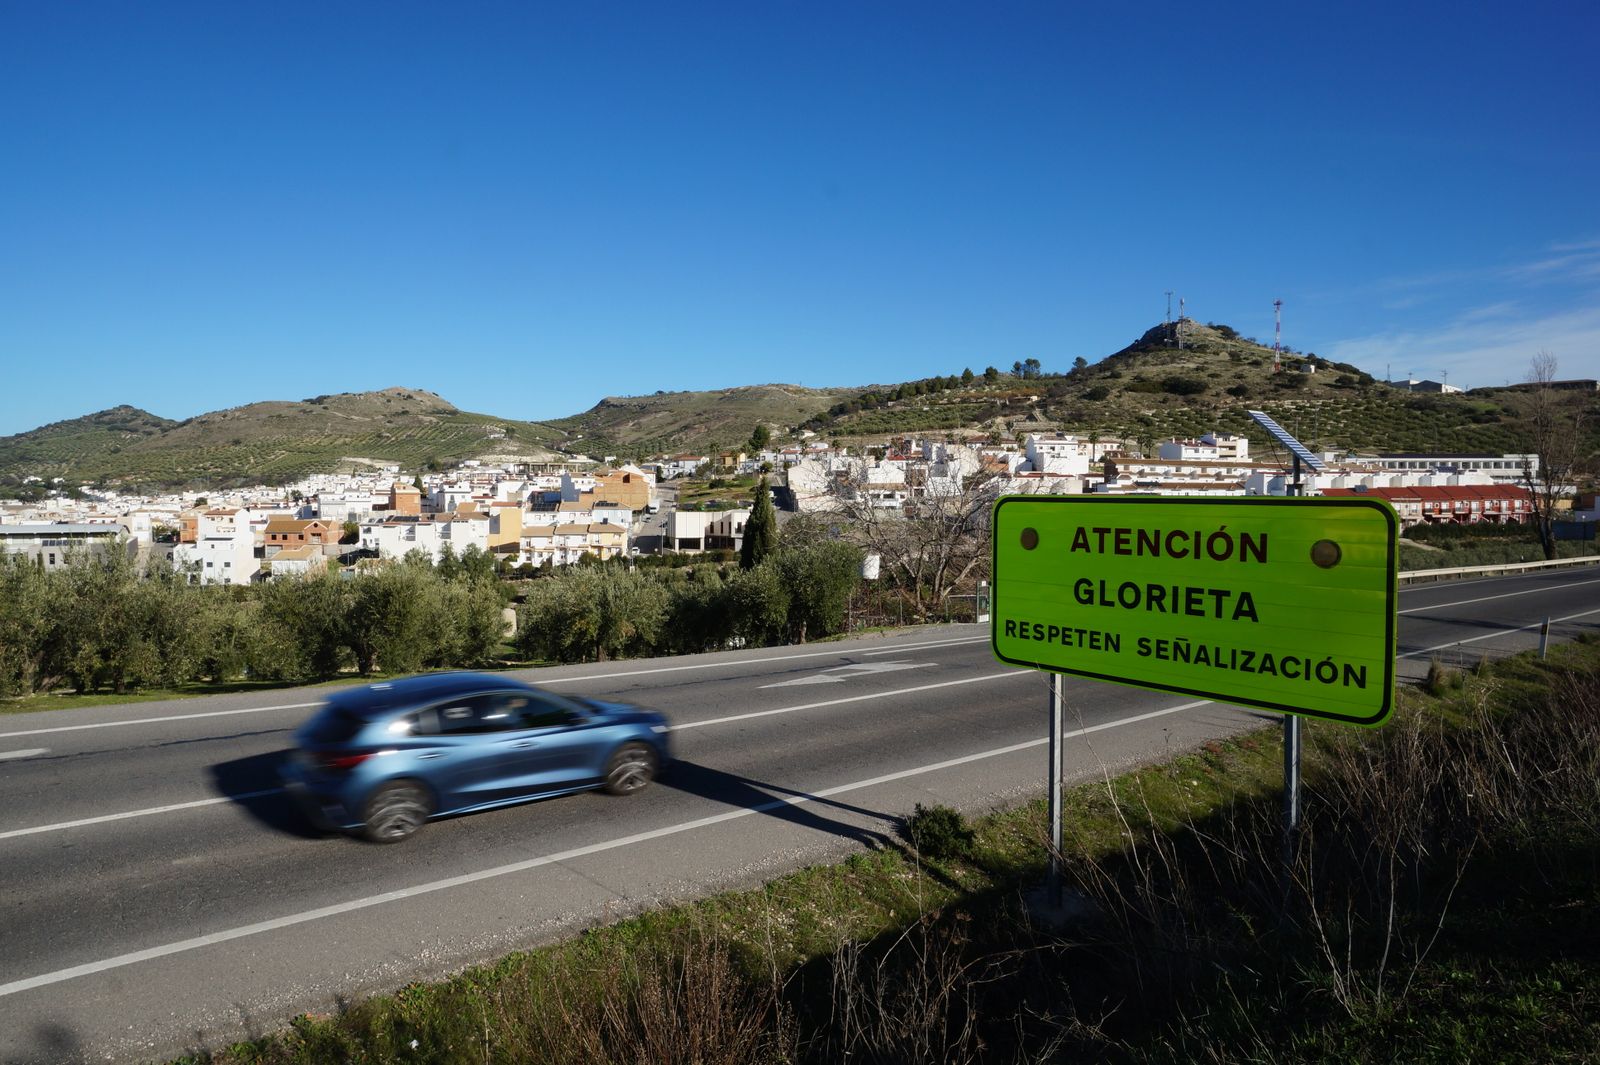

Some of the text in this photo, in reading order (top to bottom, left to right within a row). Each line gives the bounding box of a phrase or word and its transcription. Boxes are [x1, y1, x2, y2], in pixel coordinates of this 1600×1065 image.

[1070, 525, 1269, 564] ATENCIÓN
[1073, 577, 1259, 624] GLORIETA
[1005, 619, 1367, 689] RESPETEN SEÑALIZACIÓN
